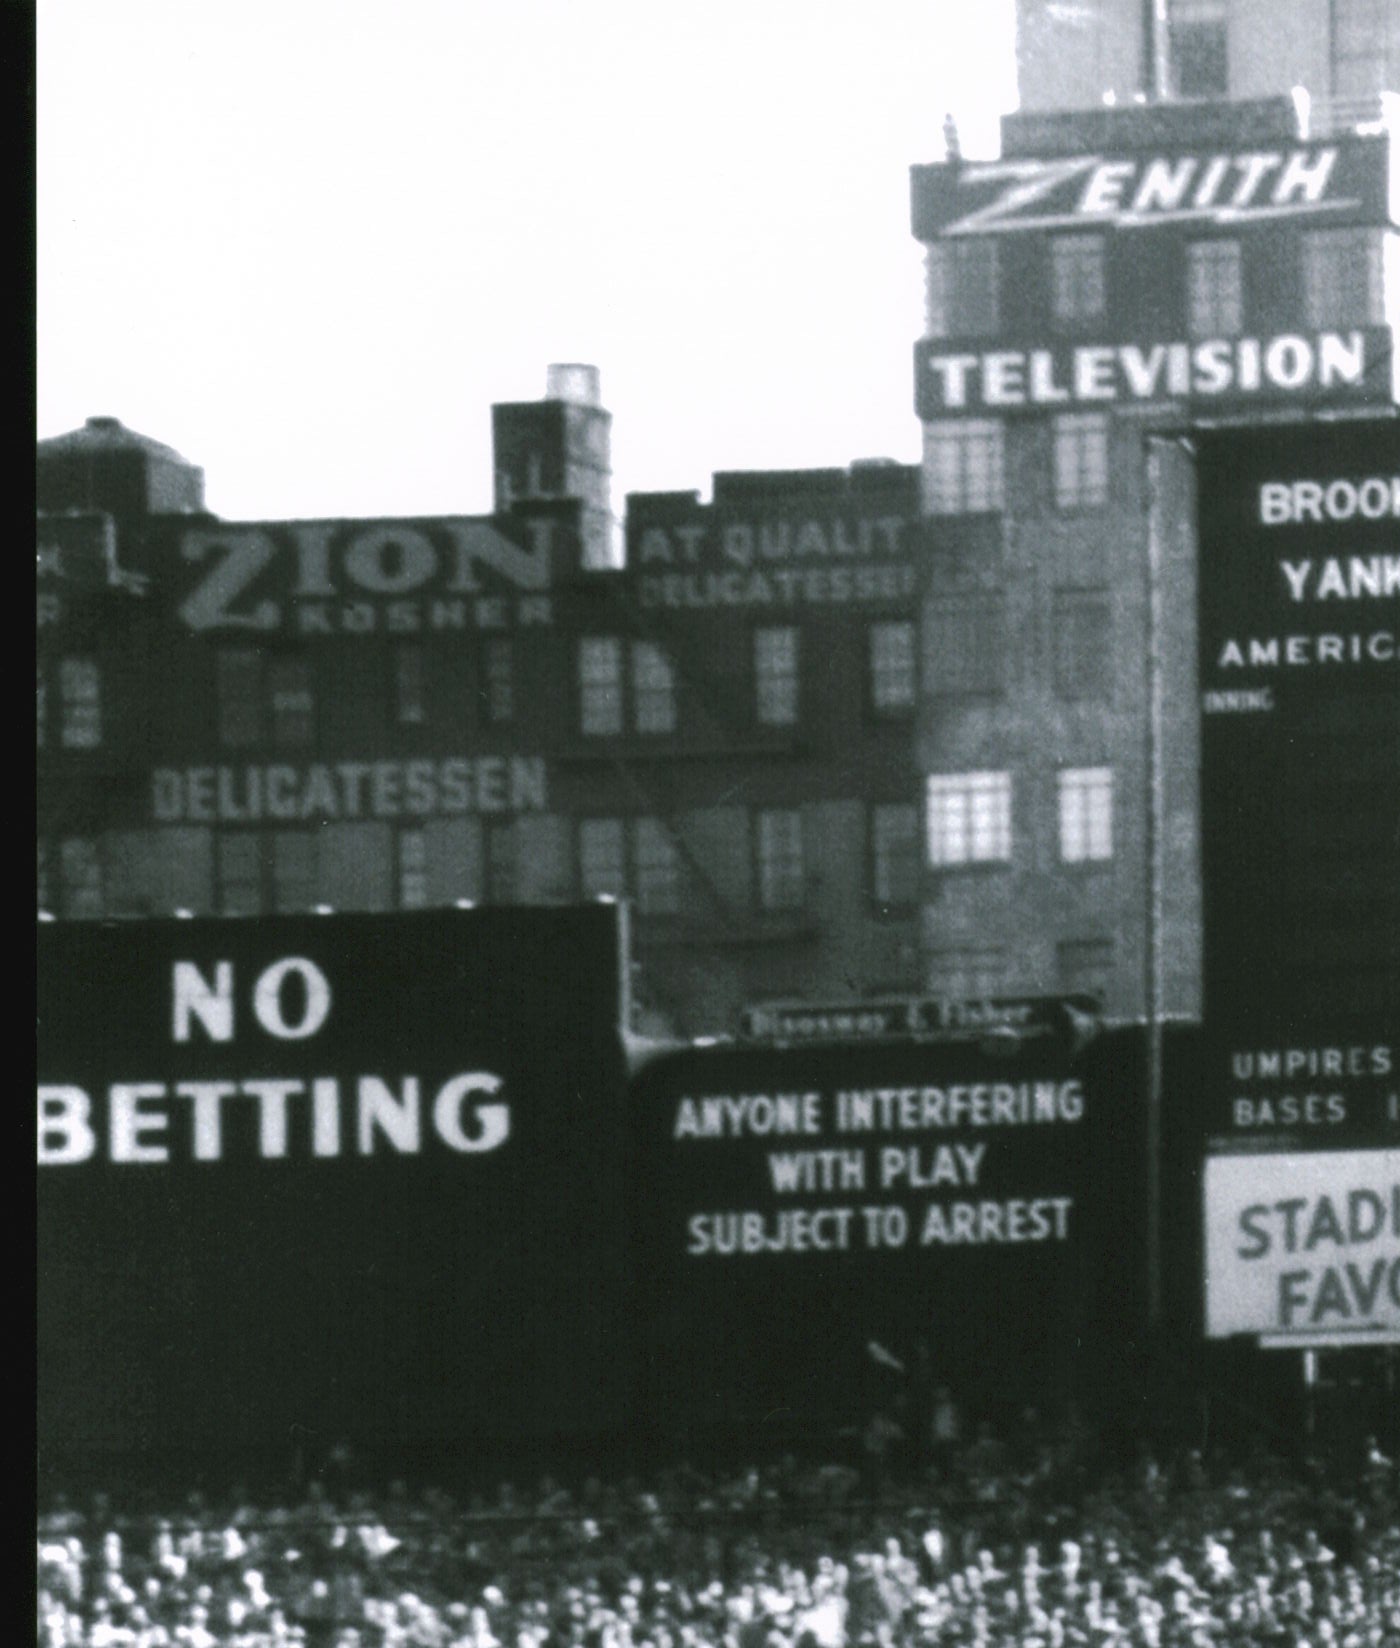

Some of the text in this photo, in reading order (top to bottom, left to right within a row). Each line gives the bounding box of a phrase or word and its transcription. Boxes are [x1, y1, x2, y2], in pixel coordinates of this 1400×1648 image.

[944, 149, 1360, 233] ZENITH
[931, 332, 1364, 407] TELEVISION
[179, 519, 554, 631] ZION
[151, 755, 548, 821] DELICATESSEN
[171, 956, 331, 1043] NO
[1233, 1047, 1392, 1079] UMPIRES
[37, 1070, 511, 1165] BETTING
[675, 1080, 1085, 1139] ANYONE INTERFERING
[1233, 1094, 1346, 1127] BASES
[768, 1142, 986, 1192] WITH PLAY
[687, 1199, 1072, 1256] SUBJECT TO ARREST
